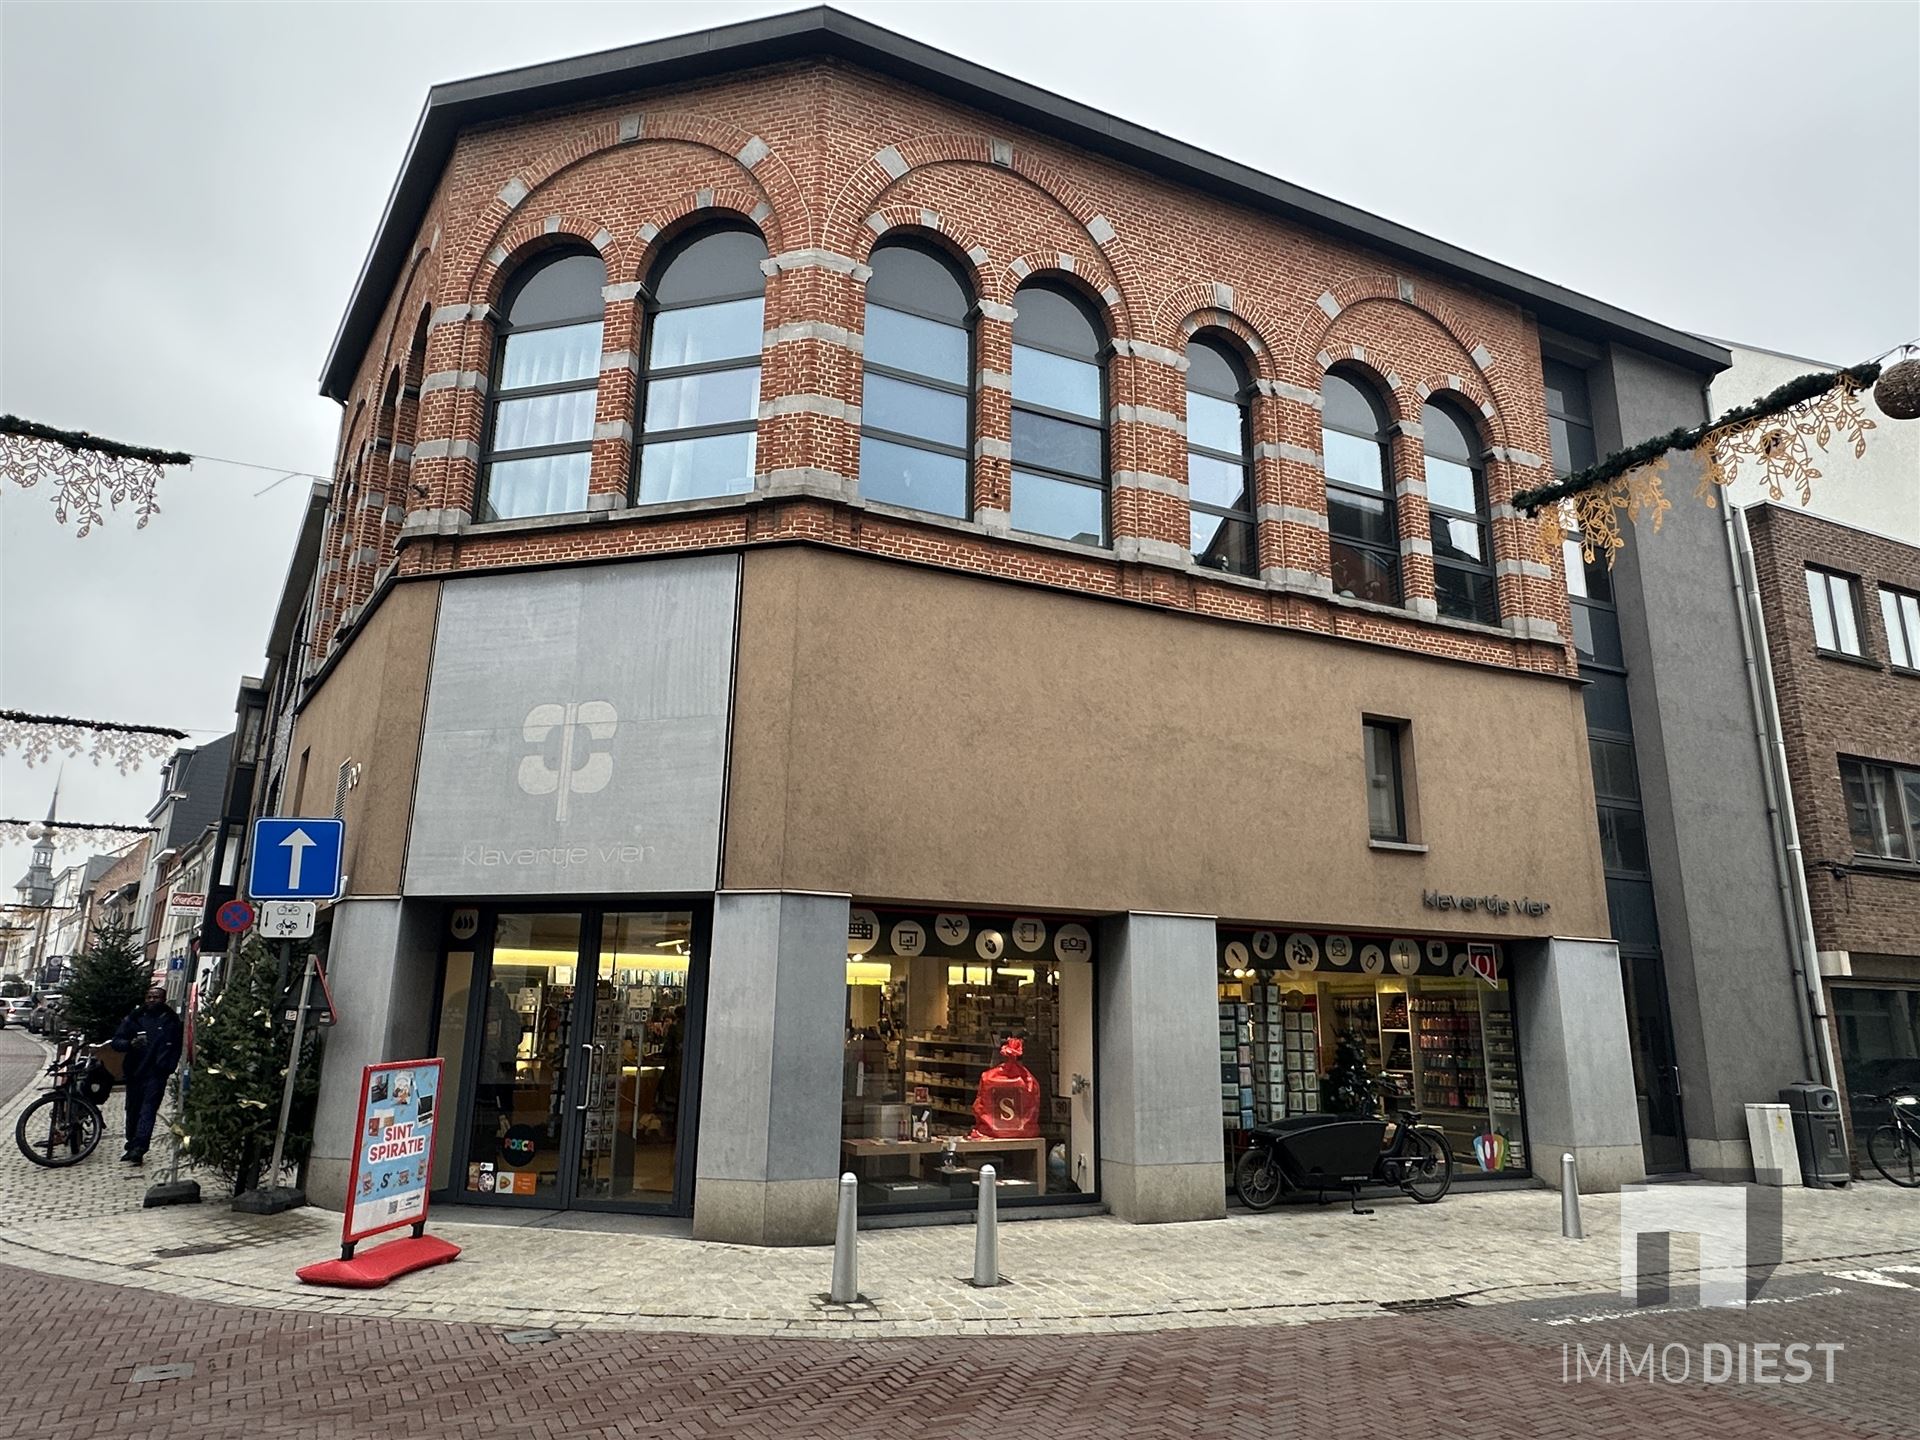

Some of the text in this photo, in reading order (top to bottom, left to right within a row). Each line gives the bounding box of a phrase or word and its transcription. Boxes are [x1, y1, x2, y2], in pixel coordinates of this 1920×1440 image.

[462, 841, 656, 869] klavertje vier
[1422, 889, 1551, 917] klavertje vier
[999, 1097, 1015, 1121] S
[384, 1123, 414, 1142] SINT
[369, 1137, 425, 1162] SPIRATIE
[504, 1138, 536, 1152] POSCA
